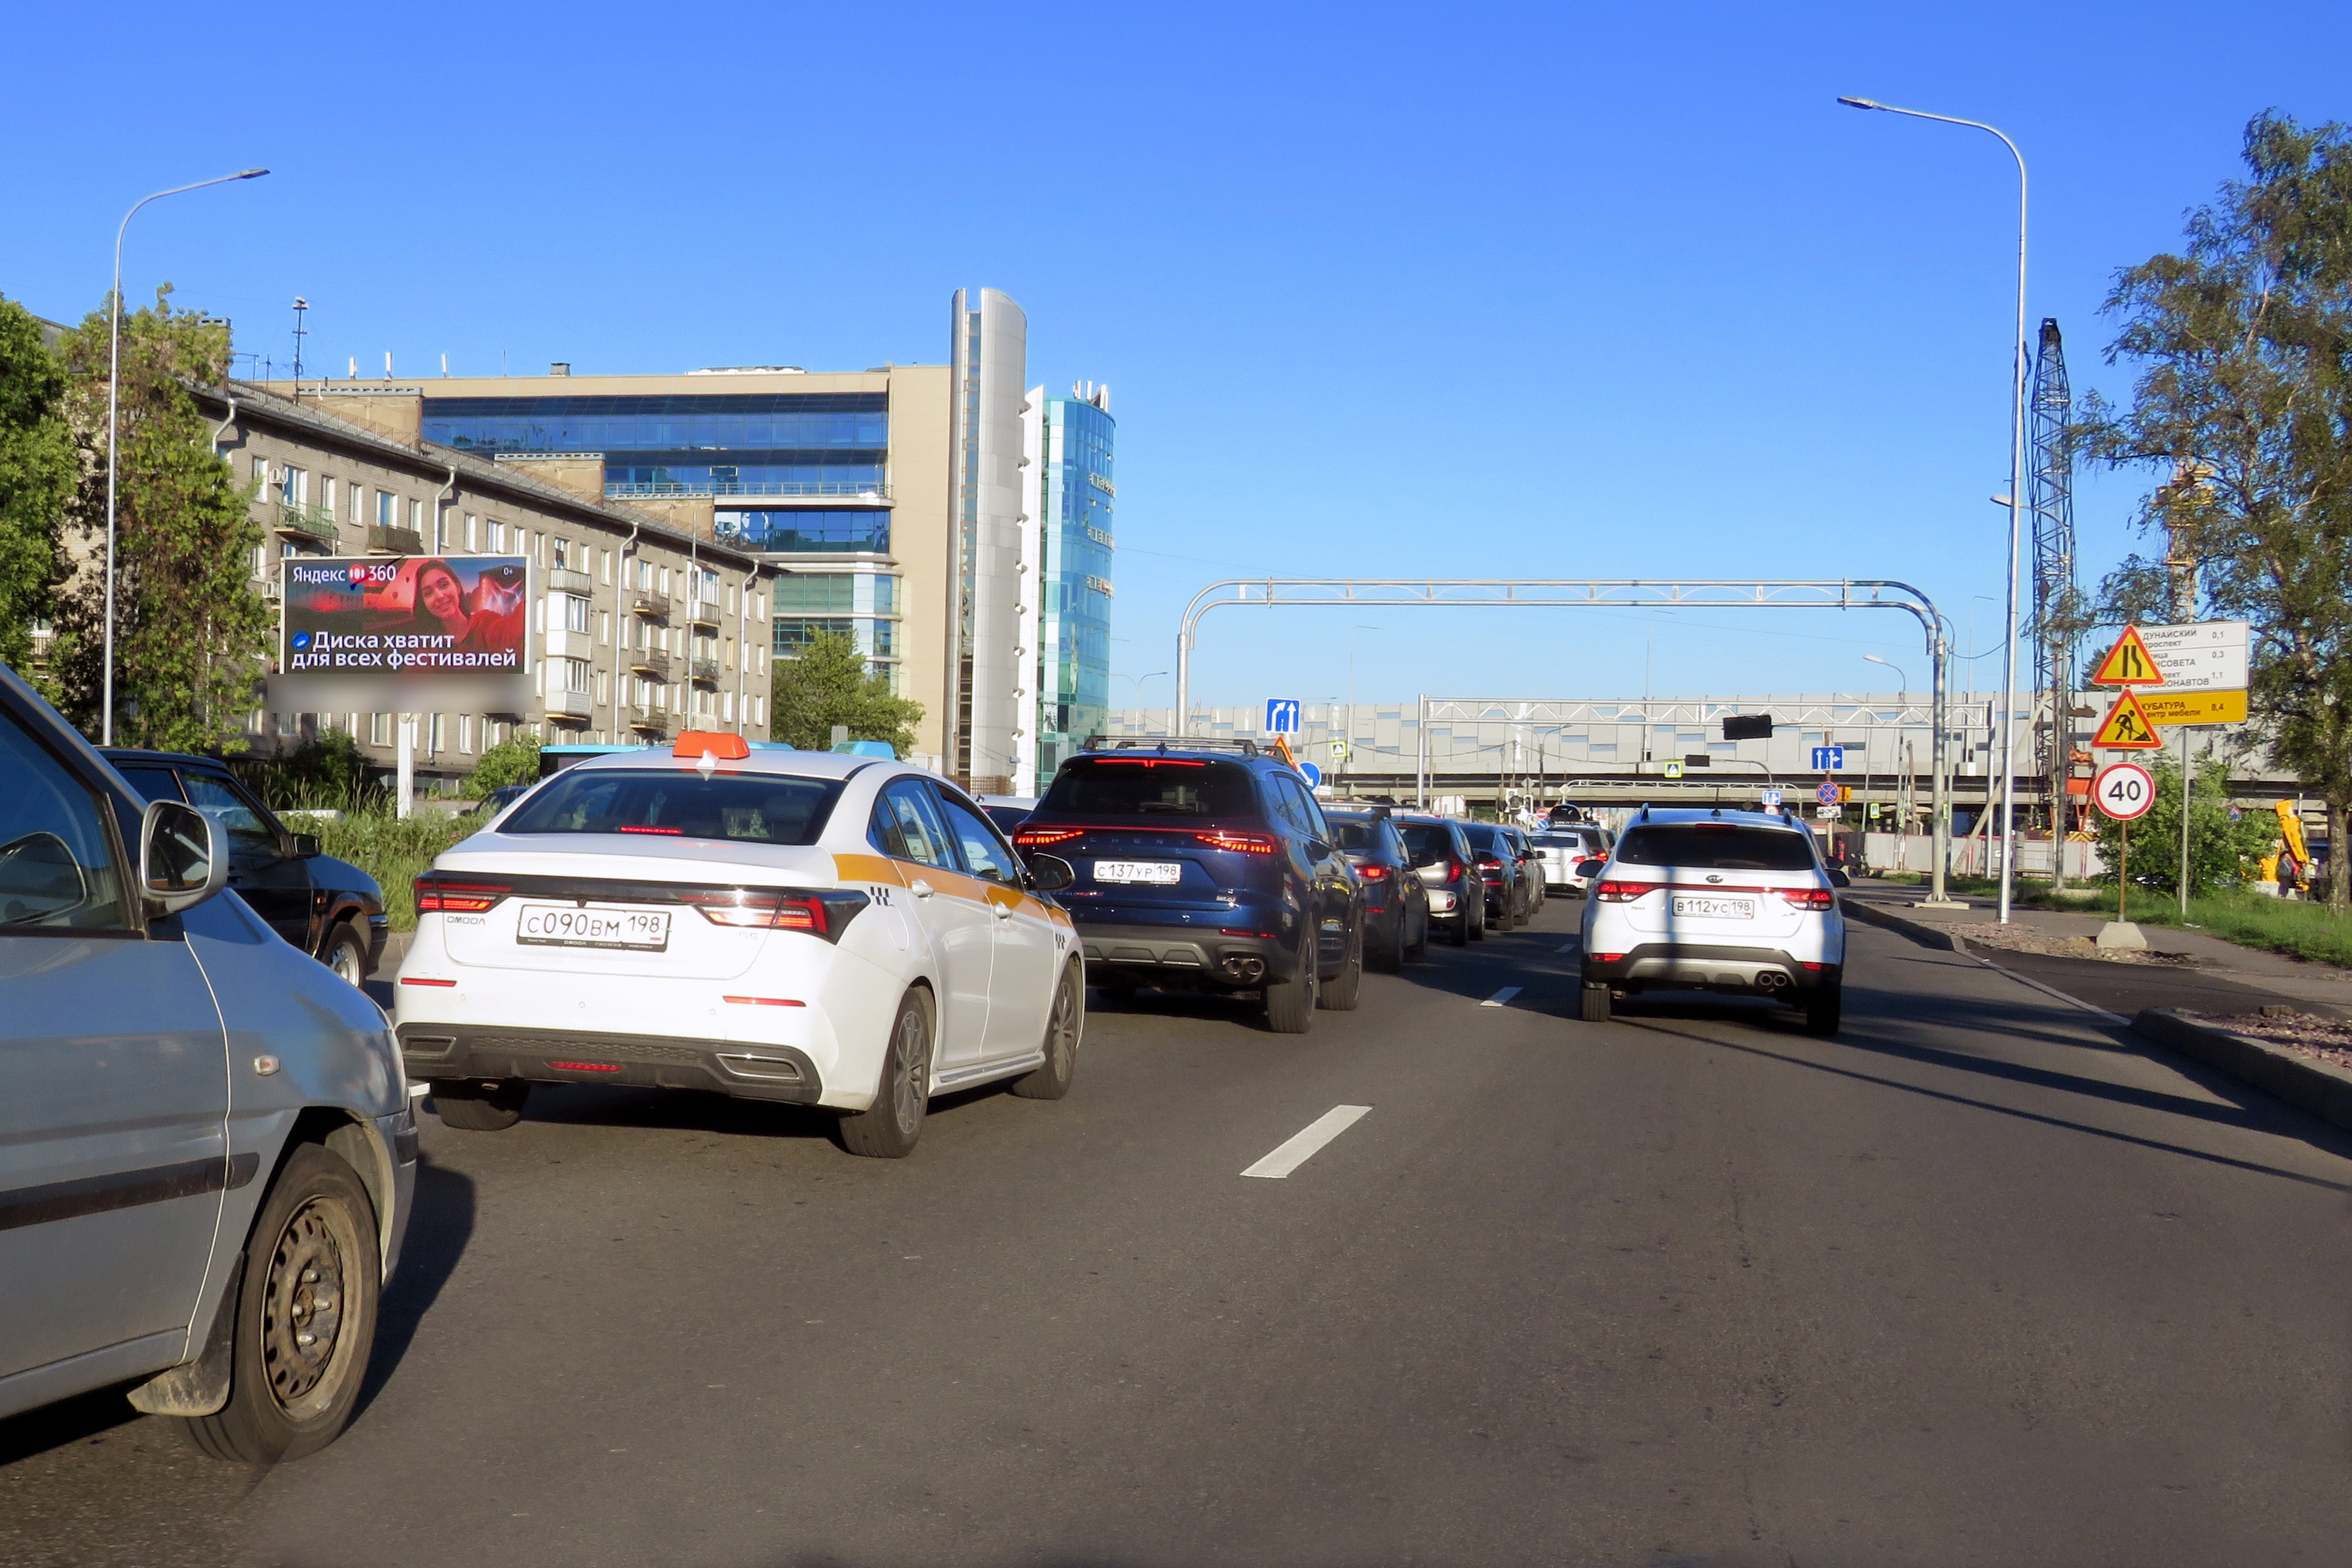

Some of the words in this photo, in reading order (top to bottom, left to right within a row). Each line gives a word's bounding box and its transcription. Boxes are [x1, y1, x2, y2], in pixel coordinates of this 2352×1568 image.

[293, 566, 346, 584] Яндекс
[368, 565, 396, 581] 360
[503, 567, 513, 576] 0+
[2143, 628, 2197, 641] ДУНАЙСКИЙ
[2212, 631, 2224, 640] 0,1
[312, 631, 379, 652] Диска
[383, 634, 455, 648] хватит
[291, 653, 330, 670] для
[335, 653, 383, 667] всех
[386, 648, 516, 670] фестивалей
[2212, 651, 2224, 659] 0,3
[2109, 780, 2141, 801] 40
[1097, 864, 1153, 878] С137УР
[1157, 865, 1177, 876] 198
[1677, 900, 1728, 913] В112УС
[1731, 901, 1750, 911] 198
[447, 916, 486, 926] OMODA
[527, 913, 620, 937] С090ВМ
[627, 915, 660, 933] 198
